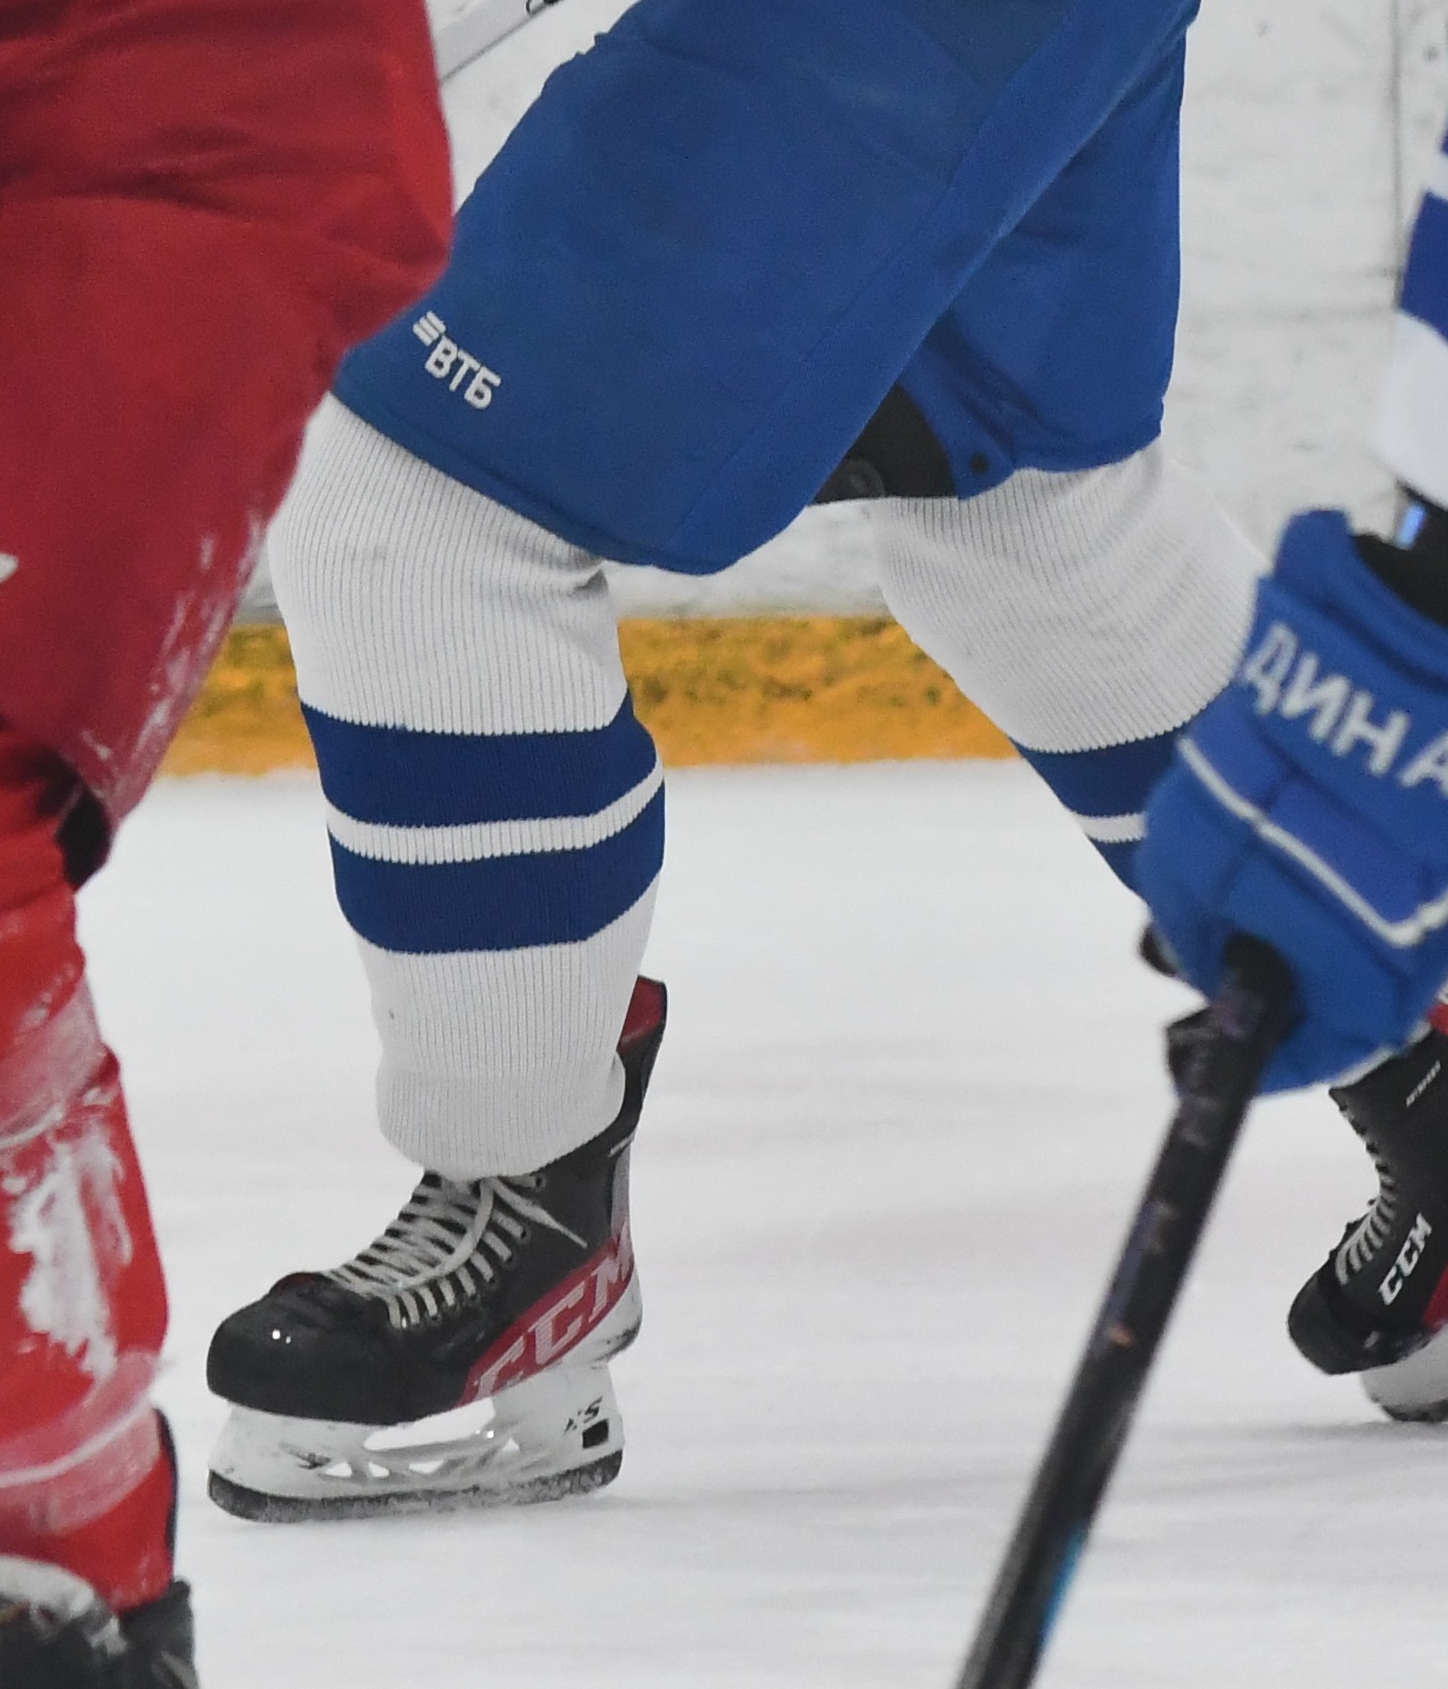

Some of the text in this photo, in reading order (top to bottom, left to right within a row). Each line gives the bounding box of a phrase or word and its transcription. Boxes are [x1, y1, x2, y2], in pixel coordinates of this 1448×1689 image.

[424, 334, 502, 410] ВТБ
[473, 1211, 633, 1395] CCM
[1377, 1212, 1433, 1306] CCM
